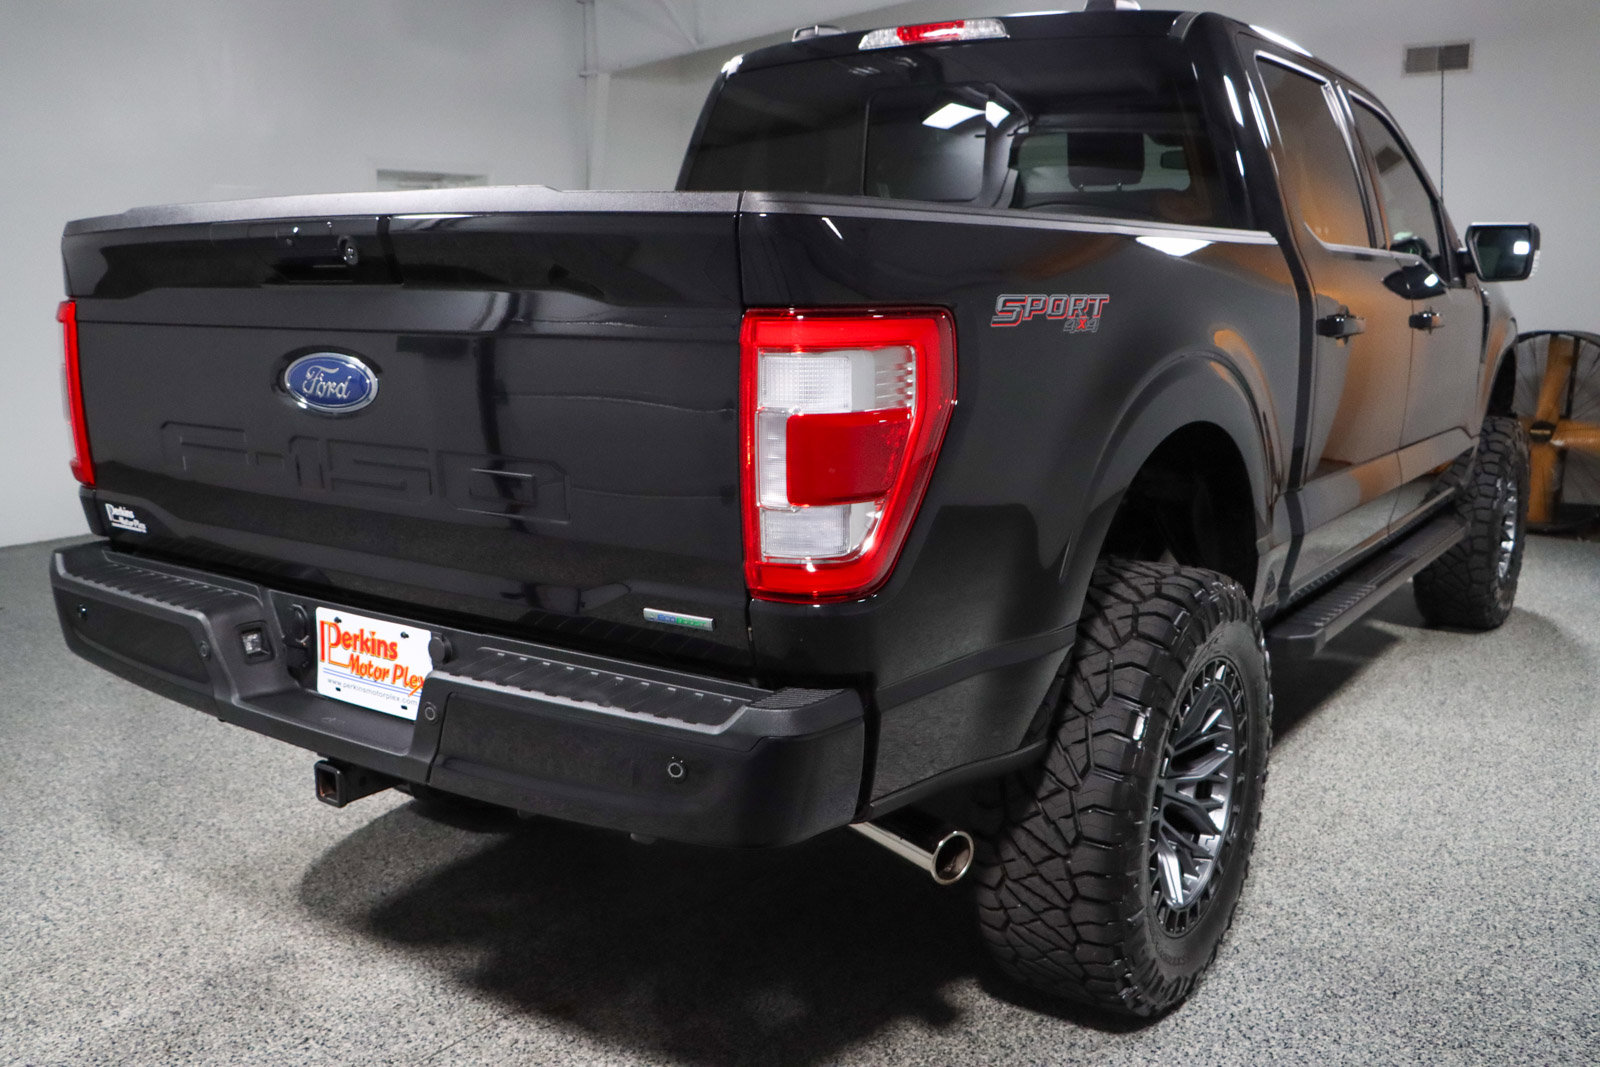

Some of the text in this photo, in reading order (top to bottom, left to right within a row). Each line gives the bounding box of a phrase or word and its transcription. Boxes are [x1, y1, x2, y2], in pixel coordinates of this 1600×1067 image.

[991, 294, 1110, 327] SPORT
[302, 365, 352, 399] Ford
[160, 421, 571, 525] F-150
[319, 620, 398, 663] Perkins
[327, 677, 418, 706] www.perkinsmotorplex.com
[348, 653, 425, 697] Motor Plex
